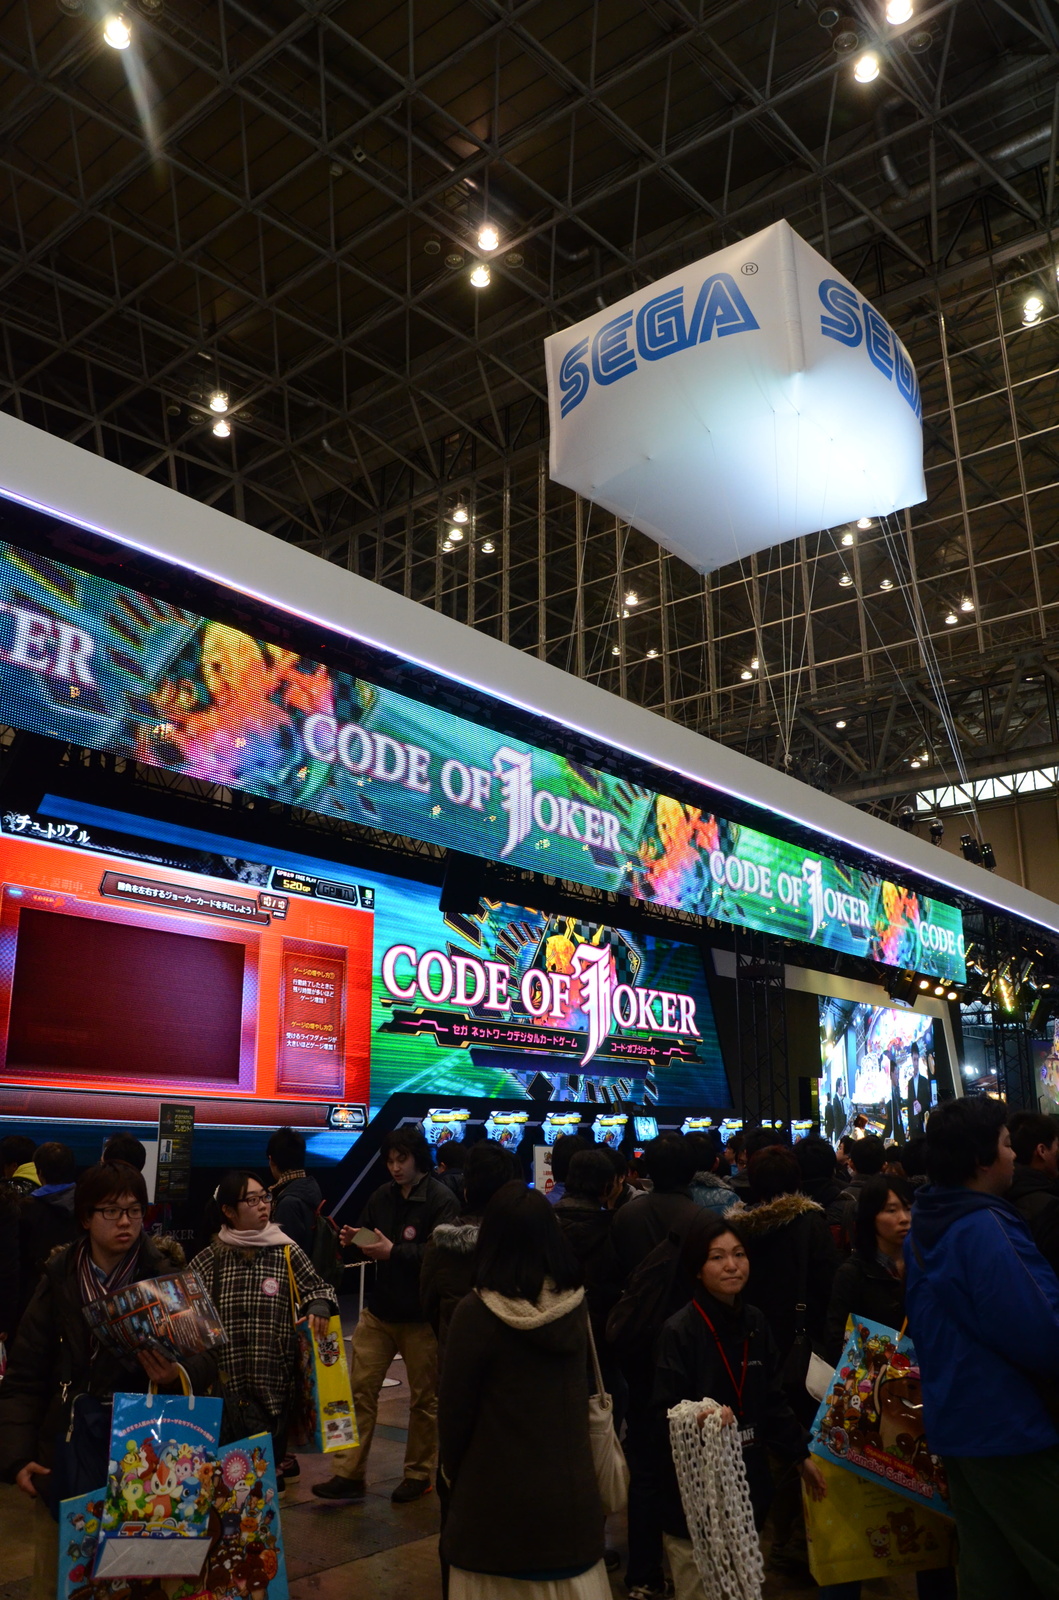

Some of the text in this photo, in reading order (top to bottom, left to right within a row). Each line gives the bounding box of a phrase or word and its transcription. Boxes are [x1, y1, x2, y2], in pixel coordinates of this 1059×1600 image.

[559, 272, 760, 419] SEGA
[818, 278, 922, 425] SEG
[0, 603, 100, 692] ER
[15, 813, 91, 844] チュートリアル
[303, 712, 624, 858] CODE OF JOKER
[709, 850, 872, 940] CODE OF JOKER
[919, 921, 956, 955] CODE
[381, 942, 700, 1068] CODE OF JOKER
[452, 1024, 578, 1048] セガ ネットワークデジタルカードゲーム
[738, 1427, 755, 1442] TAFF
[846, 1447, 886, 1478] Nameko
[885, 1466, 917, 1493] Saibai
[916, 1482, 935, 1500] Kit
